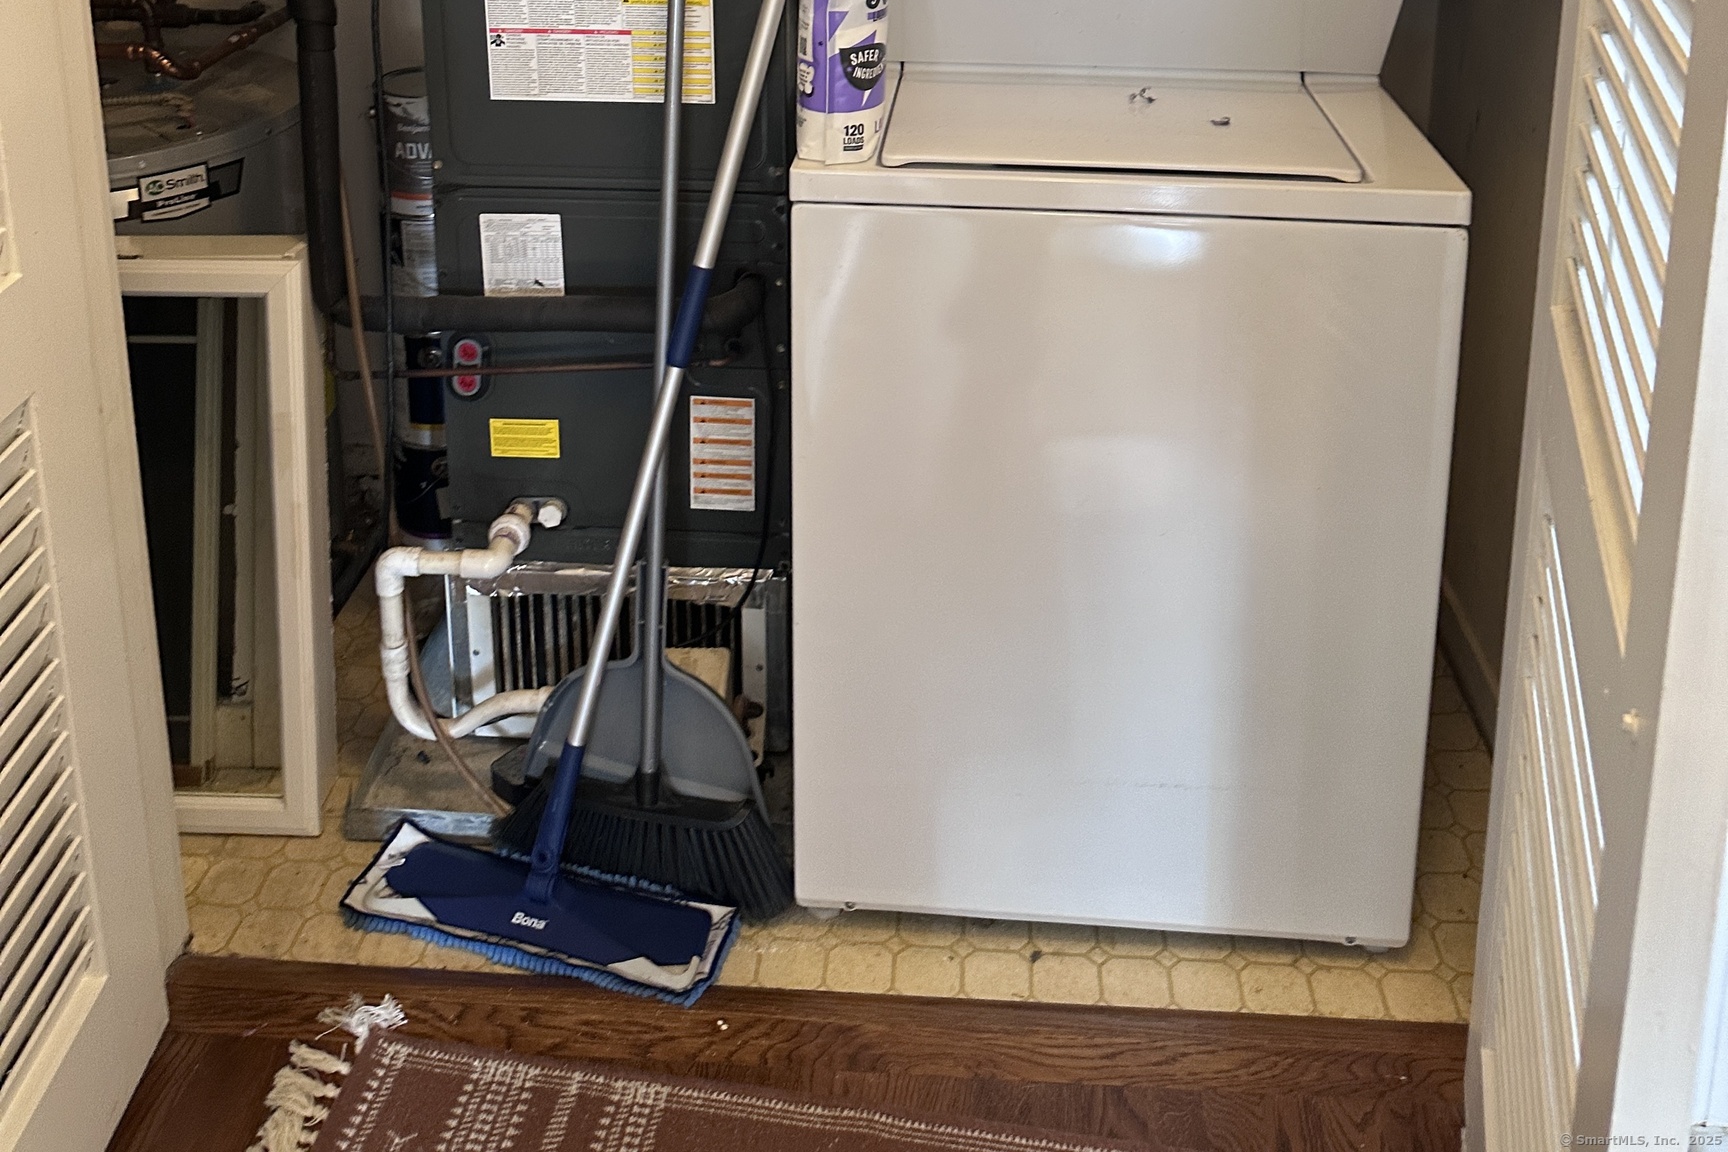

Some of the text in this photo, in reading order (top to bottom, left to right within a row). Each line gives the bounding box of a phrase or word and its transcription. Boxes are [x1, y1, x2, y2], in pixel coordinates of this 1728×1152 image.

[850, 49, 880, 66] SAFER
[843, 123, 864, 137] 120
[843, 136, 864, 145] LOADS
[511, 911, 550, 930] Bona
